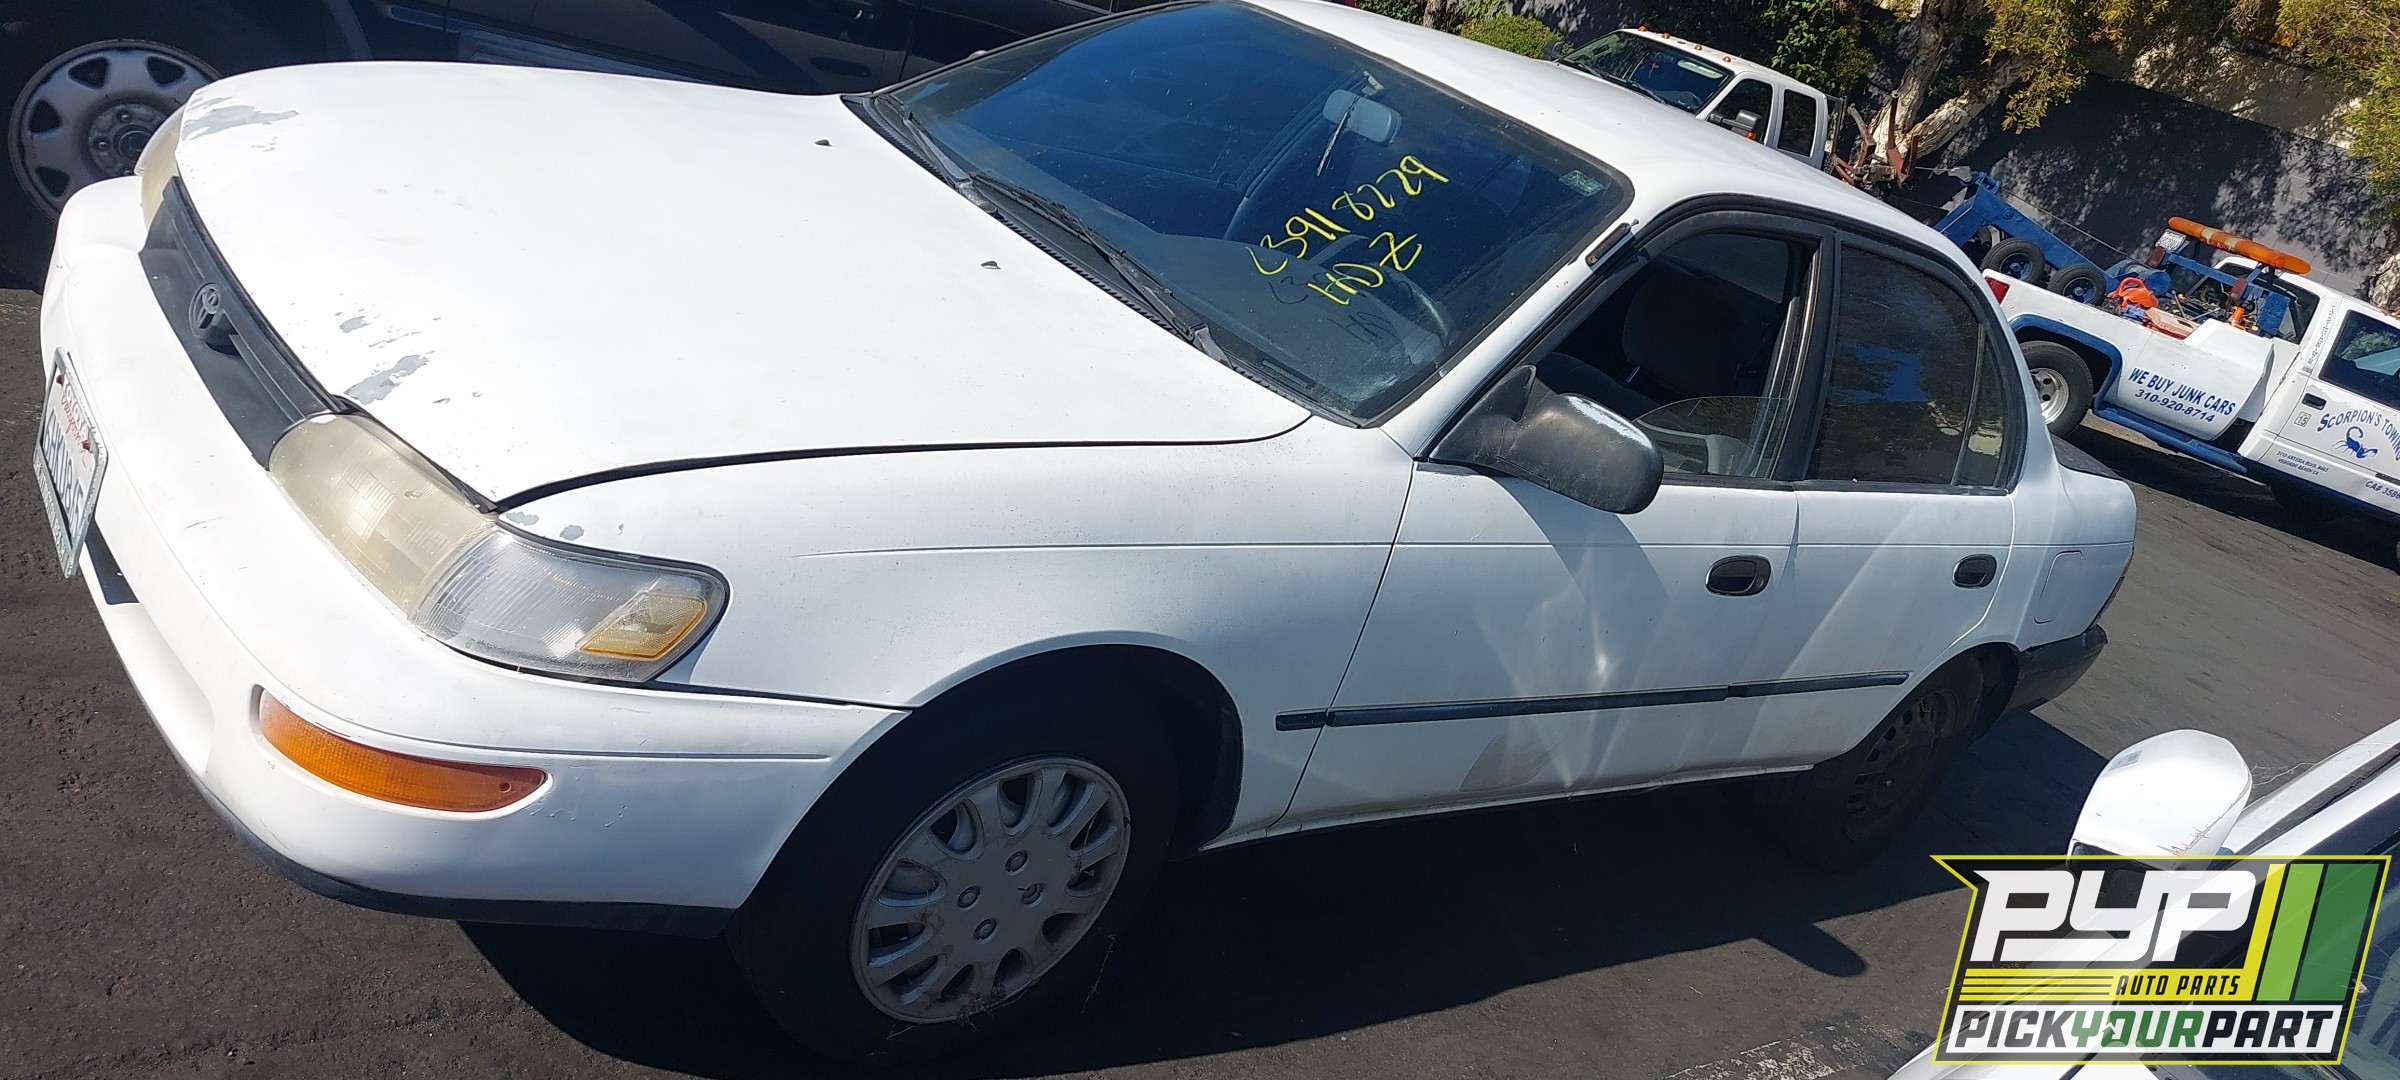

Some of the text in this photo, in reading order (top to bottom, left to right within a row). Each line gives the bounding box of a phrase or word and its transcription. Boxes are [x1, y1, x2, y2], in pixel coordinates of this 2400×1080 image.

[2128, 367, 2236, 416] WE BUY JUNK CARS
[2134, 388, 2216, 423] 310-920-8714
[2298, 415, 2309, 427] 15
[2365, 480, 2384, 492] CA#
